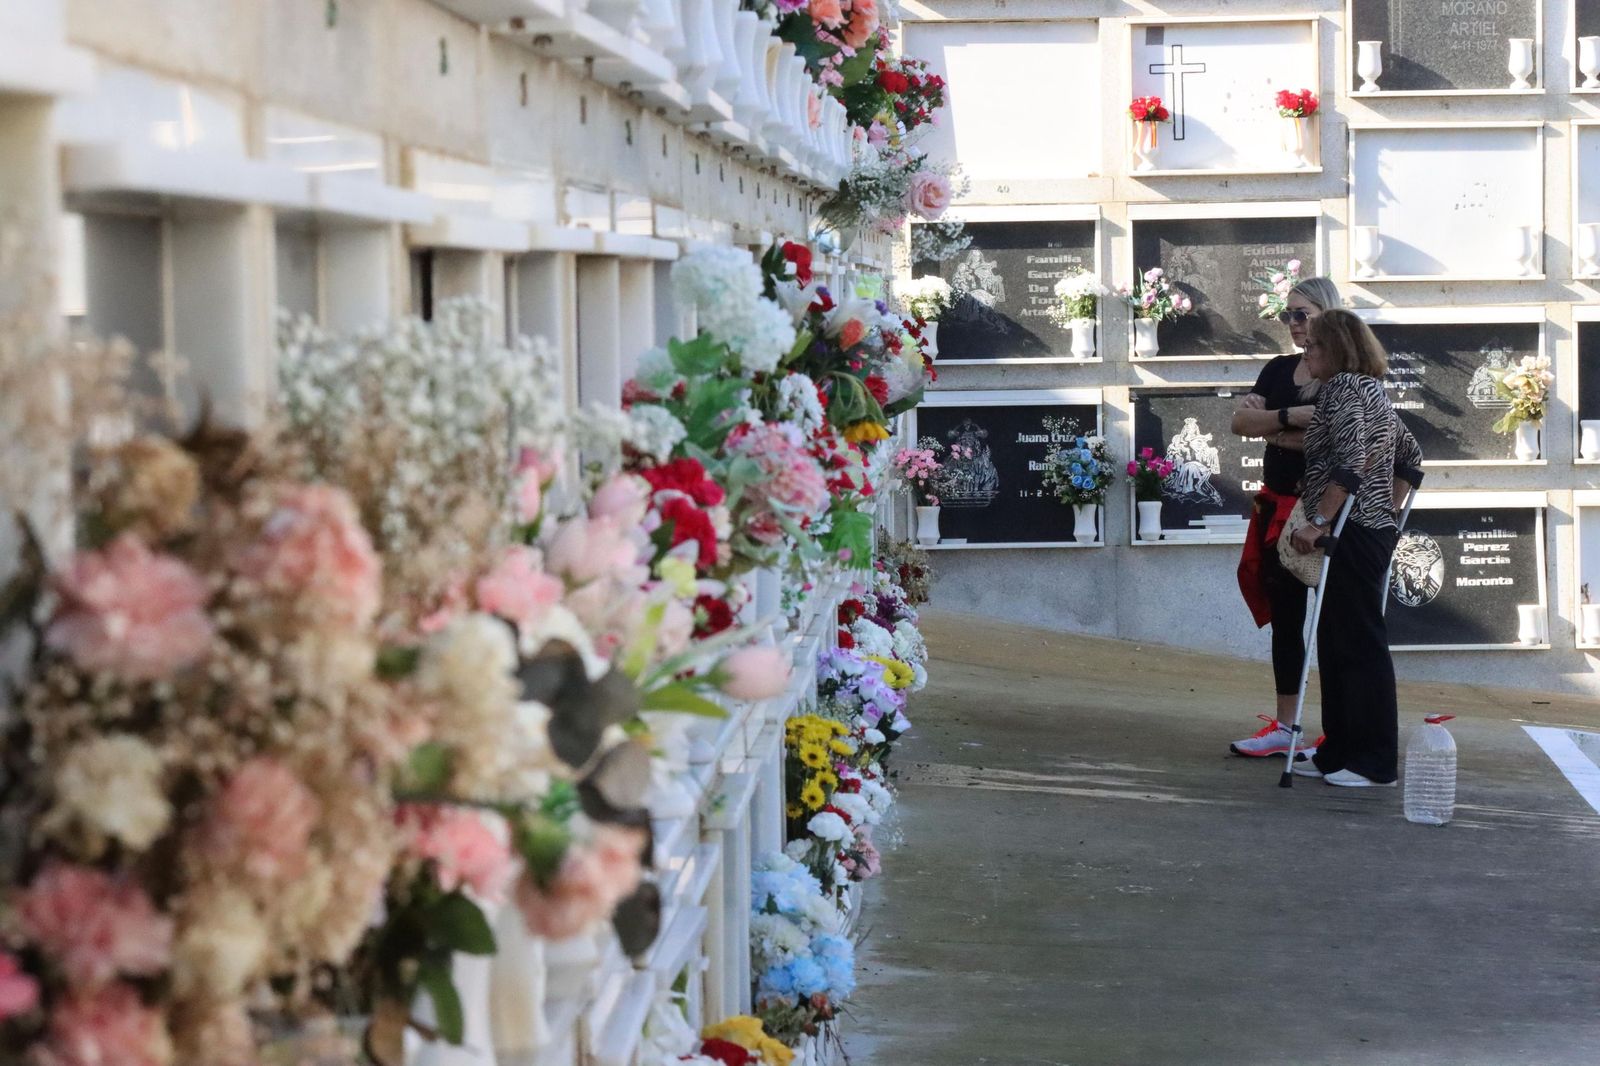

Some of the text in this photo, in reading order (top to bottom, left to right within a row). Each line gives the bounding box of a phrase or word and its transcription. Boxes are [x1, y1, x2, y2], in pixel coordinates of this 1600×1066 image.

[1027, 254, 1082, 264] Familia
[1015, 432, 1049, 443] Juana
[1458, 529, 1518, 539] Familia
[1463, 542, 1511, 552] Perez
[1456, 576, 1515, 587] Moronta
